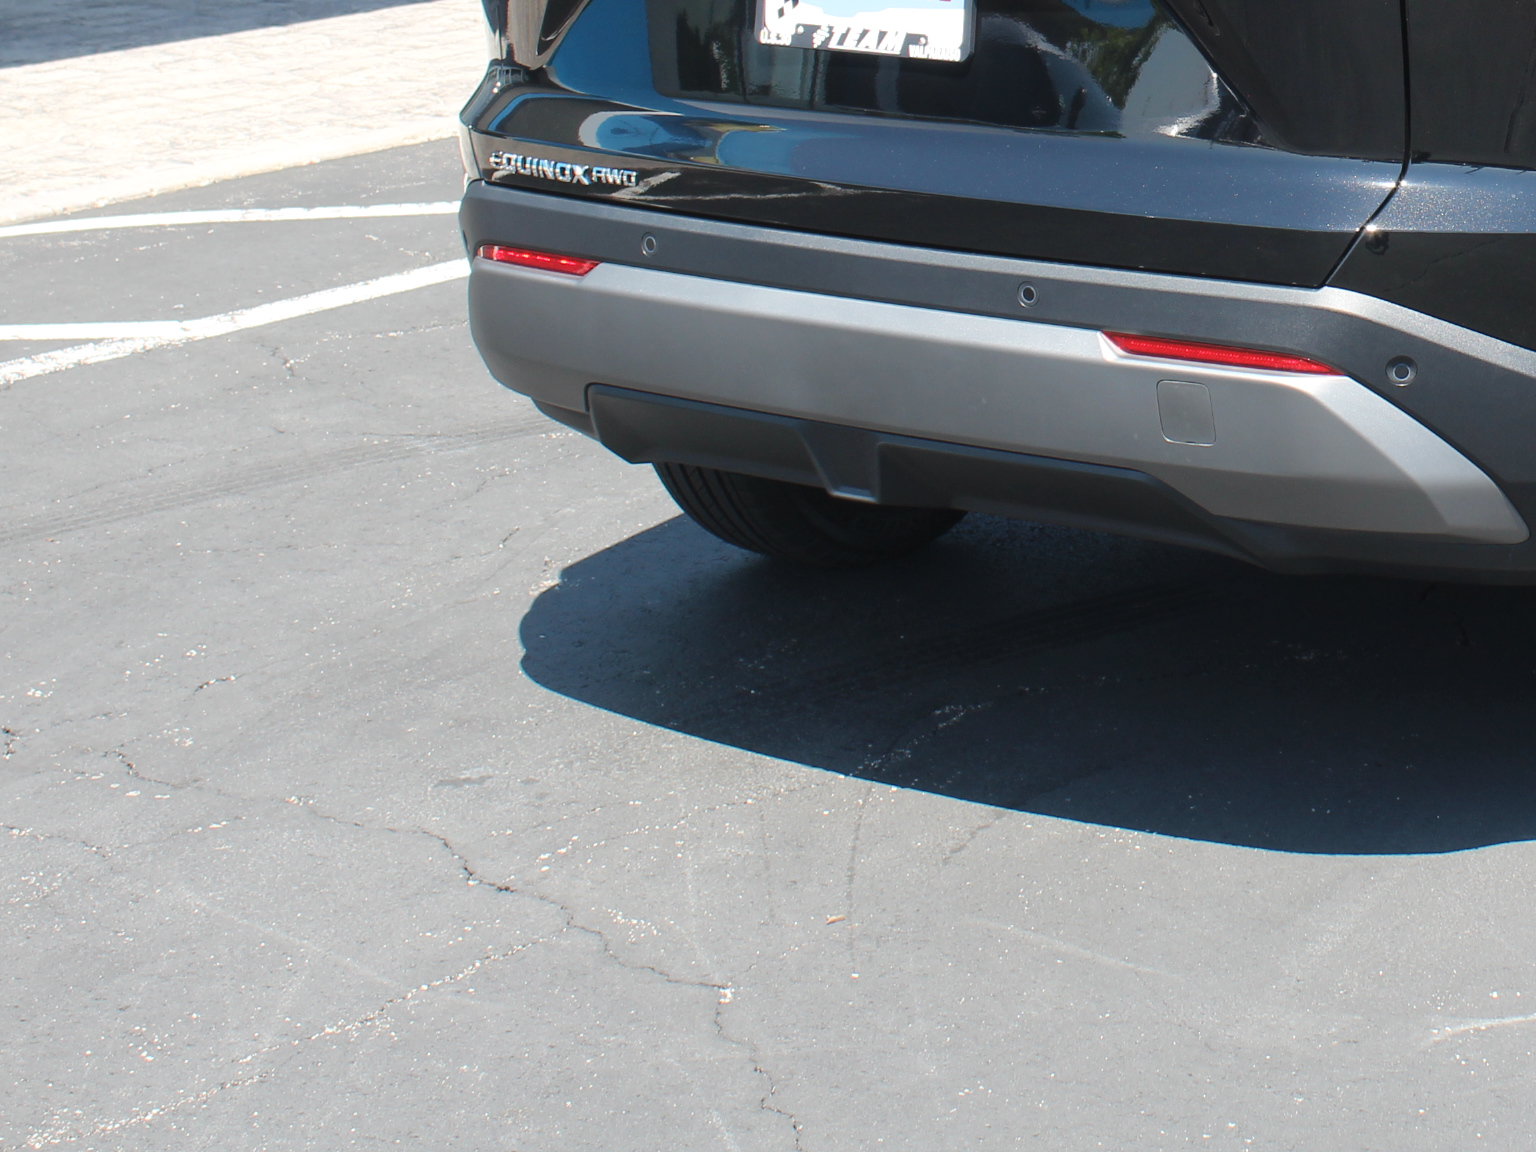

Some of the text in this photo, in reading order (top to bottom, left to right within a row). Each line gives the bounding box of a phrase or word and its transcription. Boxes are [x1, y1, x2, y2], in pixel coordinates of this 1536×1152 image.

[828, 25, 908, 52] TEAM
[489, 151, 639, 187] EQUINOX AWD
